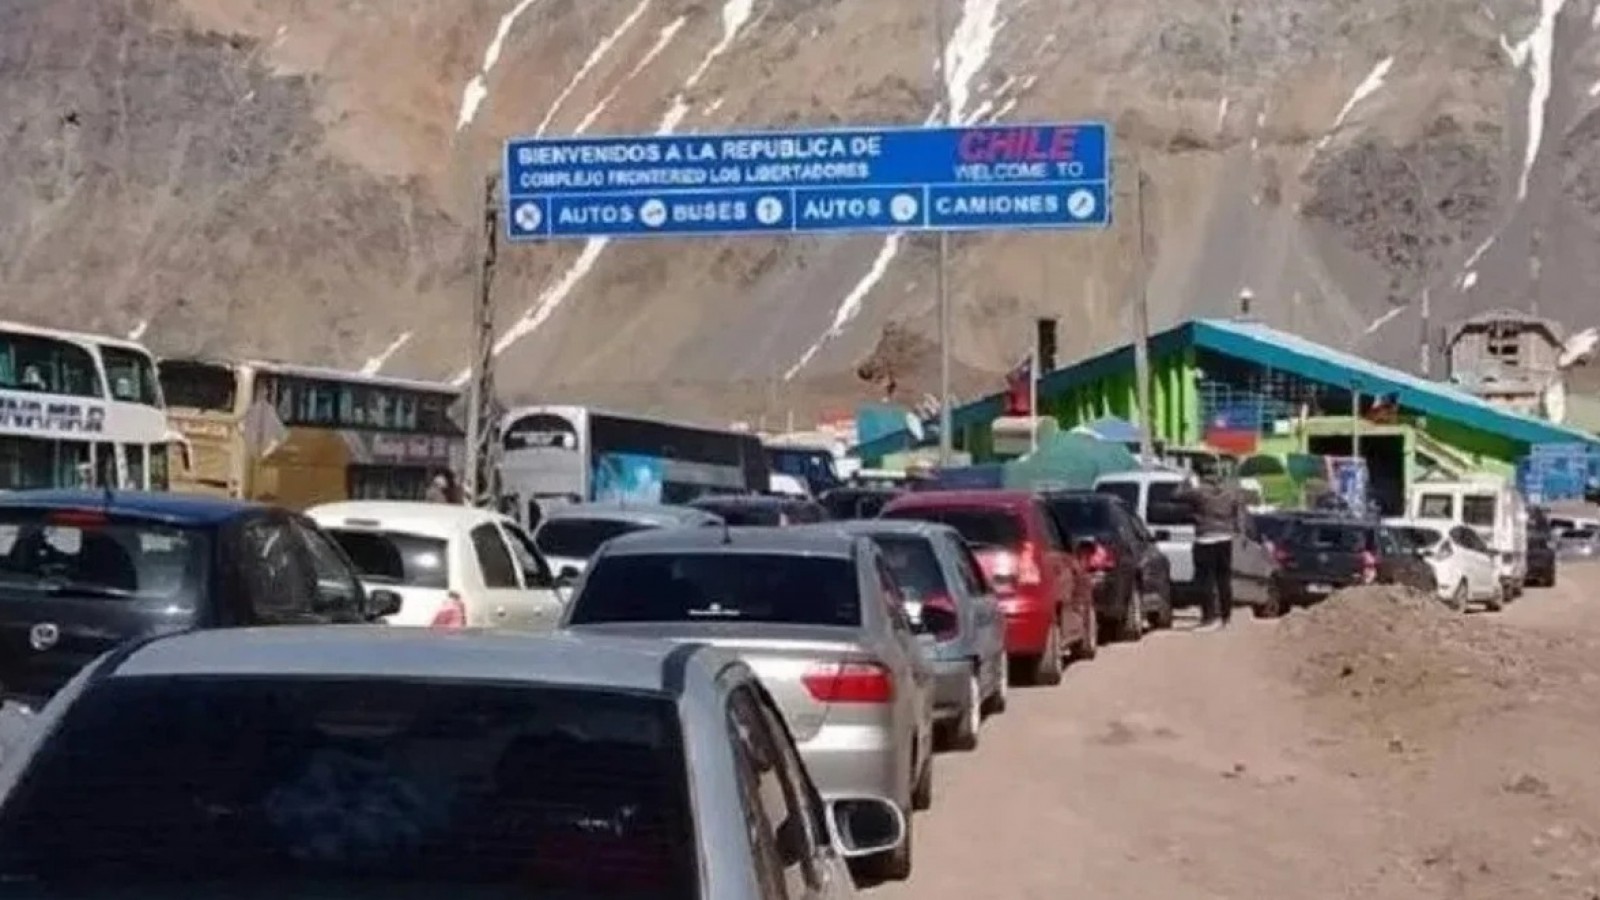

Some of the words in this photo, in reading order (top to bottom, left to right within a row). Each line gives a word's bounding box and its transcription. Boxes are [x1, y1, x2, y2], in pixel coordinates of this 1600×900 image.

[518, 144, 661, 165] BIENVENIDOS
[664, 143, 682, 162] A
[686, 142, 716, 161] LA
[721, 137, 846, 160] REPUBLICA
[851, 136, 882, 156] DE
[958, 127, 1079, 163] CHILE
[520, 170, 605, 188] COMPLEJO
[710, 165, 741, 183] LOS
[745, 162, 870, 182] LIBERTADORES
[954, 162, 1048, 180] WELCOME
[1056, 161, 1084, 178] TO
[559, 204, 634, 224] AUTOS
[672, 201, 747, 221] BUSES
[803, 197, 882, 219] AUTOS
[935, 194, 1059, 215] CAMIONES
